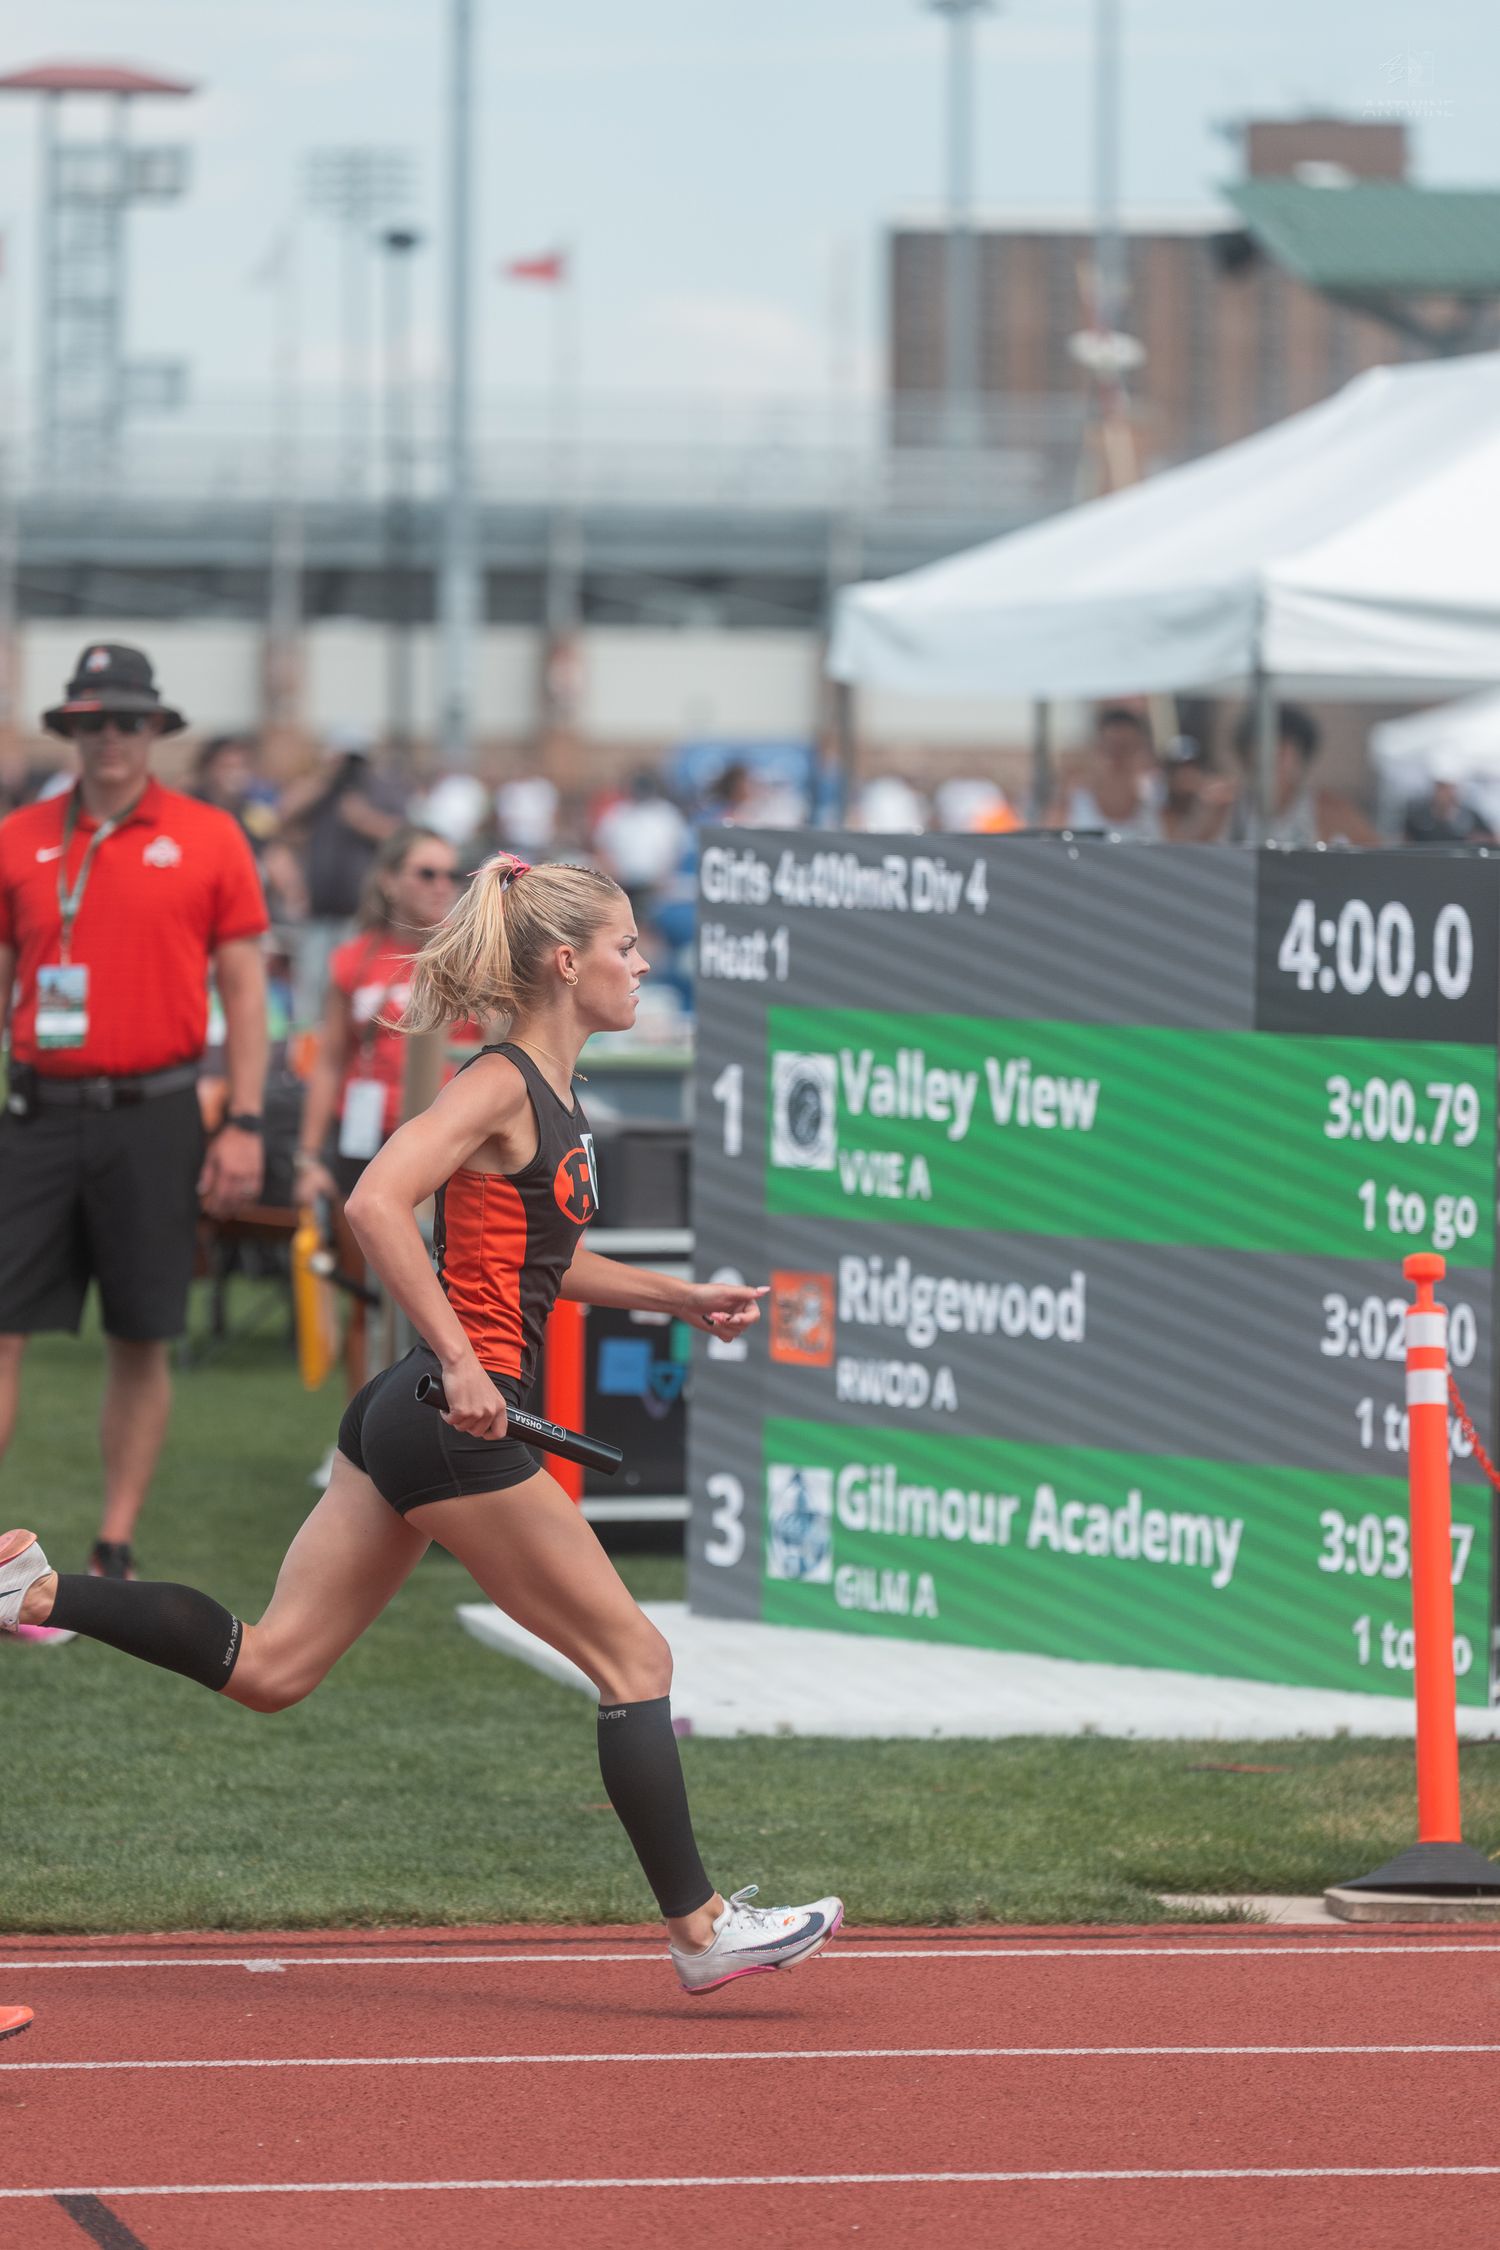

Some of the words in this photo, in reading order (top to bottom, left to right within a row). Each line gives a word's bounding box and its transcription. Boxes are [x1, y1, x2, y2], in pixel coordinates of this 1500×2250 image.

[701, 846, 770, 905] Girls
[773, 849, 908, 912] 4x400mR
[911, 856, 964, 914] Div
[965, 858, 989, 915] 4
[701, 922, 768, 982] Heat
[771, 925, 789, 982] 1
[1278, 898, 1474, 1000] 4:00.0
[712, 1063, 743, 1157] 1
[839, 1047, 979, 1142] Valley
[984, 1057, 1100, 1131] View
[1324, 1074, 1480, 1147] 3:00.79
[906, 1153, 932, 1202] A
[1358, 1179, 1376, 1231] 1
[1386, 1184, 1426, 1234] to
[1432, 1194, 1478, 1250] go
[838, 1253, 1086, 1348] Ridgewood
[1320, 1292, 1477, 1367] 3:020
[836, 1356, 930, 1409] RWOD
[932, 1365, 958, 1412] A
[515, 1413, 542, 1430] OHSAA
[1355, 1397, 1373, 1449] 1
[704, 1472, 745, 1567] 3
[837, 1462, 1021, 1547] Gilmour
[1026, 1482, 1244, 1590] Academy
[1318, 1509, 1475, 1586] 3:037
[835, 1563, 910, 1616] GILM
[911, 1572, 939, 1619] A
[1352, 1614, 1371, 1666] 1
[1453, 1634, 1473, 1677] o
